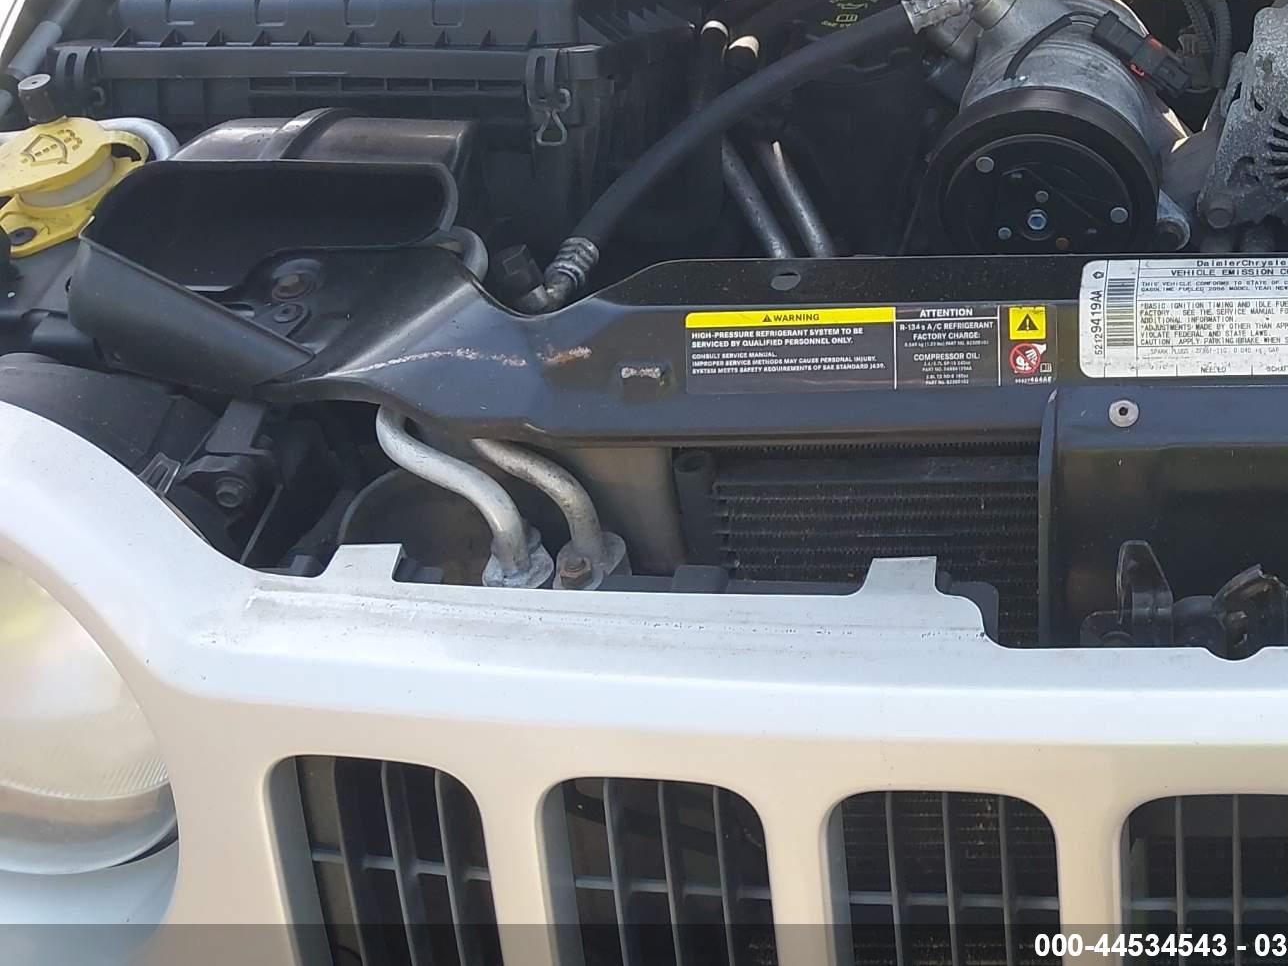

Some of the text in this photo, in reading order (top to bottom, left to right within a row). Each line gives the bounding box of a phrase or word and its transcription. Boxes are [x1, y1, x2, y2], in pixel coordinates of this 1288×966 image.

[773, 314, 819, 322] WARNING
[920, 308, 973, 318] ATTENTION
[691, 329, 754, 340] HIGH-PRESSURE
[755, 329, 808, 337] REFRIGERANT
[691, 340, 729, 348] SERVICED
[742, 338, 783, 347] QUALIFIED
[784, 338, 830, 346] PERSONNEL
